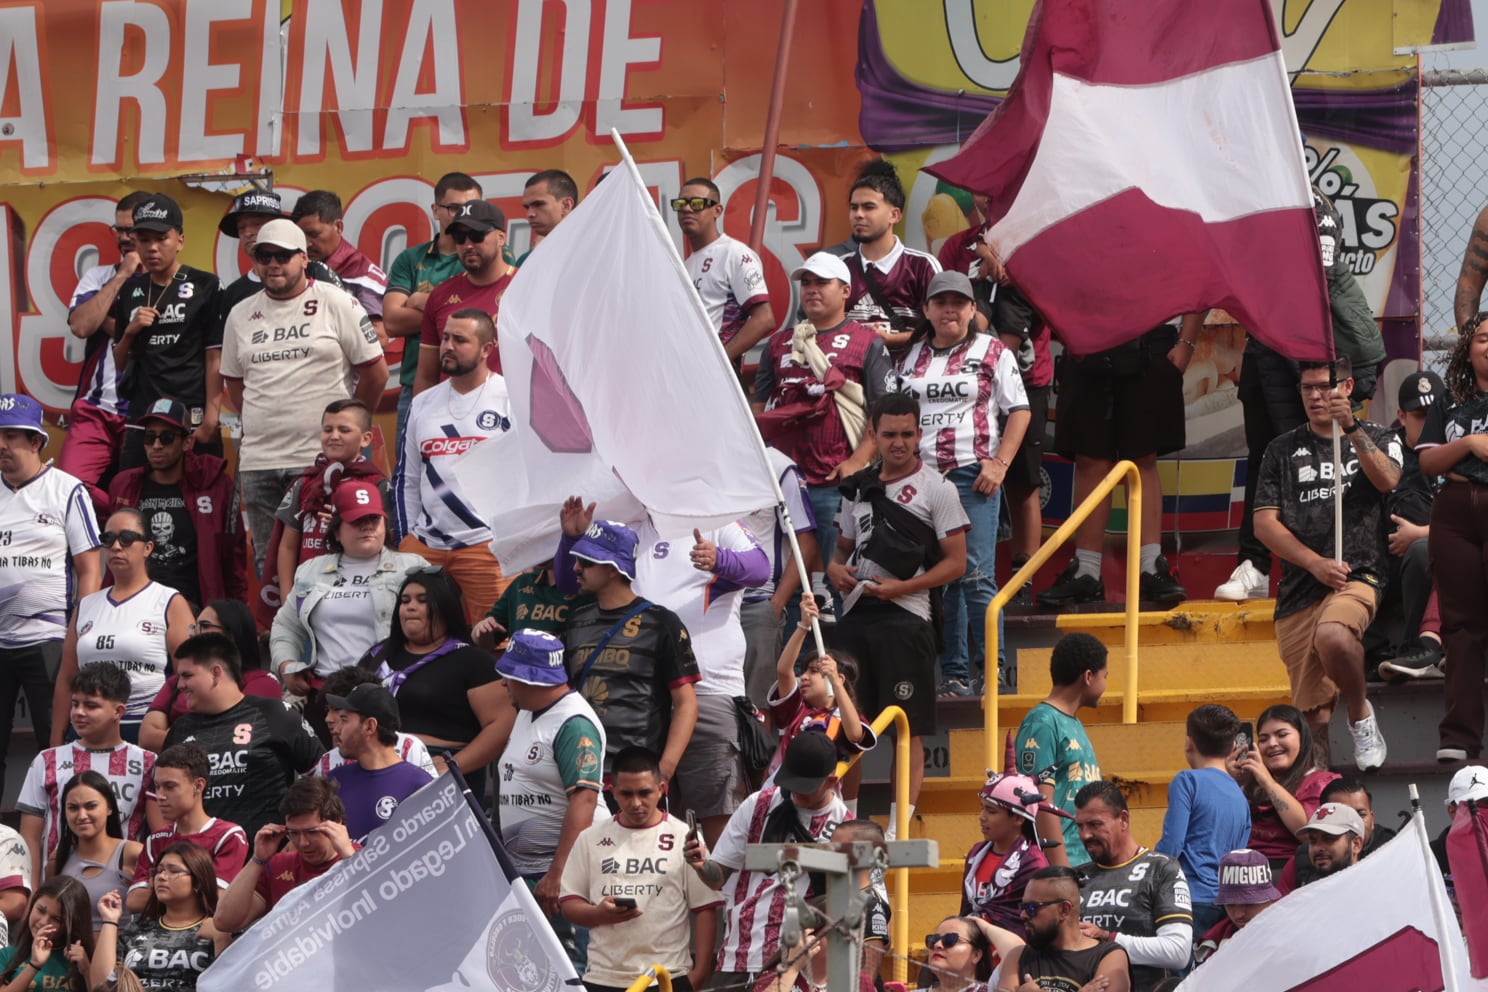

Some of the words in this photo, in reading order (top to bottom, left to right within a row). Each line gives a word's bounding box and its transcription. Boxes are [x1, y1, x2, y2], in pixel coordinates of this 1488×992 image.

[92, 0, 462, 168] REINA
[508, 0, 666, 145] DE
[273, 323, 310, 342] BAC
[251, 347, 310, 364] LIBERTY
[926, 381, 968, 399] BAC
[420, 438, 474, 456] Colga
[12, 555, 40, 568] TIBAS
[42, 555, 52, 569] NO
[352, 575, 370, 586] BA
[322, 591, 370, 601] LIBERT
[531, 603, 570, 624] BAC
[96, 634, 115, 651] 85
[232, 723, 253, 745] S
[208, 750, 249, 771] BAC
[625, 857, 668, 875] BAC
[1128, 862, 1150, 882] S
[1221, 864, 1267, 886] MIGUEL
[601, 883, 664, 897] LIBERTY
[1086, 888, 1132, 908] BAC
[148, 947, 210, 972] BAC
